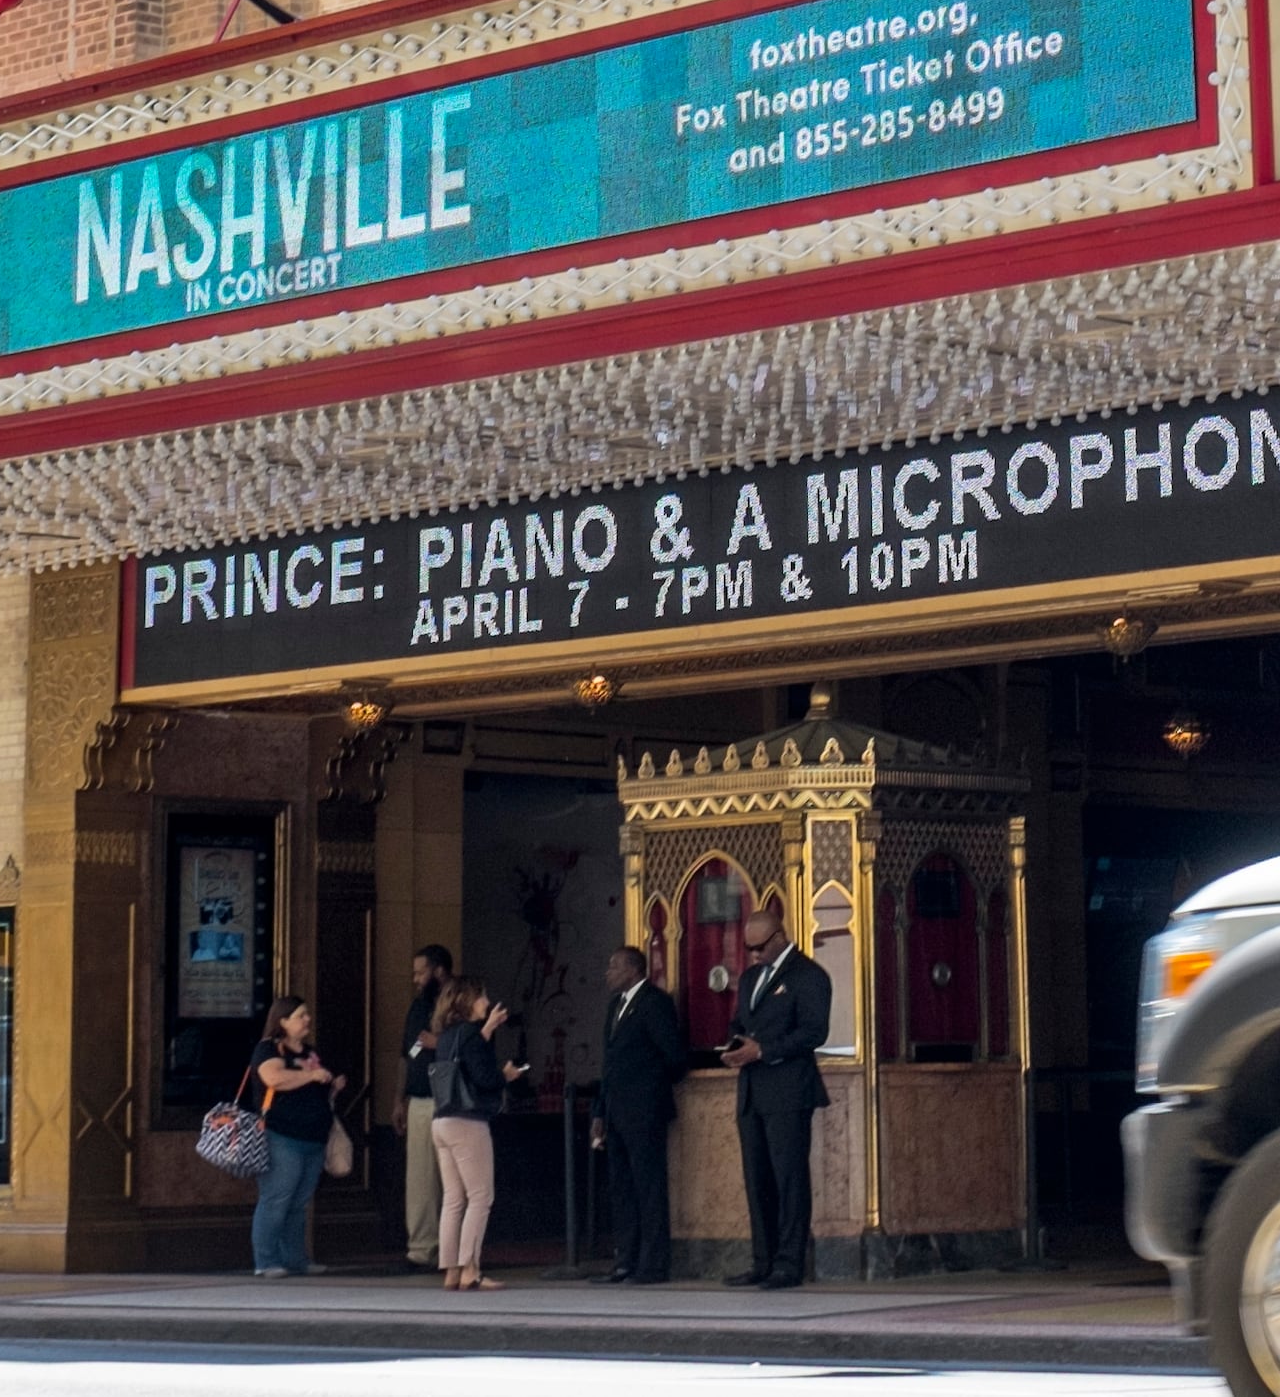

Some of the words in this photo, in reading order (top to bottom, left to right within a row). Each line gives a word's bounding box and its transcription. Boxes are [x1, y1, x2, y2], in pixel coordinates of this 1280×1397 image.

[676, 104, 726, 136] Fox
[735, 75, 851, 122] Theatre
[860, 49, 955, 95] Ticket
[965, 30, 1064, 73] Office
[749, 2, 979, 71] foxtheatre.org,
[729, 132, 785, 173] and
[795, 86, 1006, 161] 855-285-8499
[75, 89, 472, 303] NASHVILLE
[185, 280, 211, 313] IN
[217, 253, 343, 306] CONCERT
[143, 536, 386, 628] PRINCE:
[418, 503, 617, 593] PIANO
[649, 493, 696, 565] &
[726, 482, 774, 556] A
[409, 588, 543, 647] APRIL
[567, 579, 591, 628] 7
[653, 559, 753, 618] 7PM
[780, 553, 814, 603] &
[841, 530, 979, 595] 10PM
